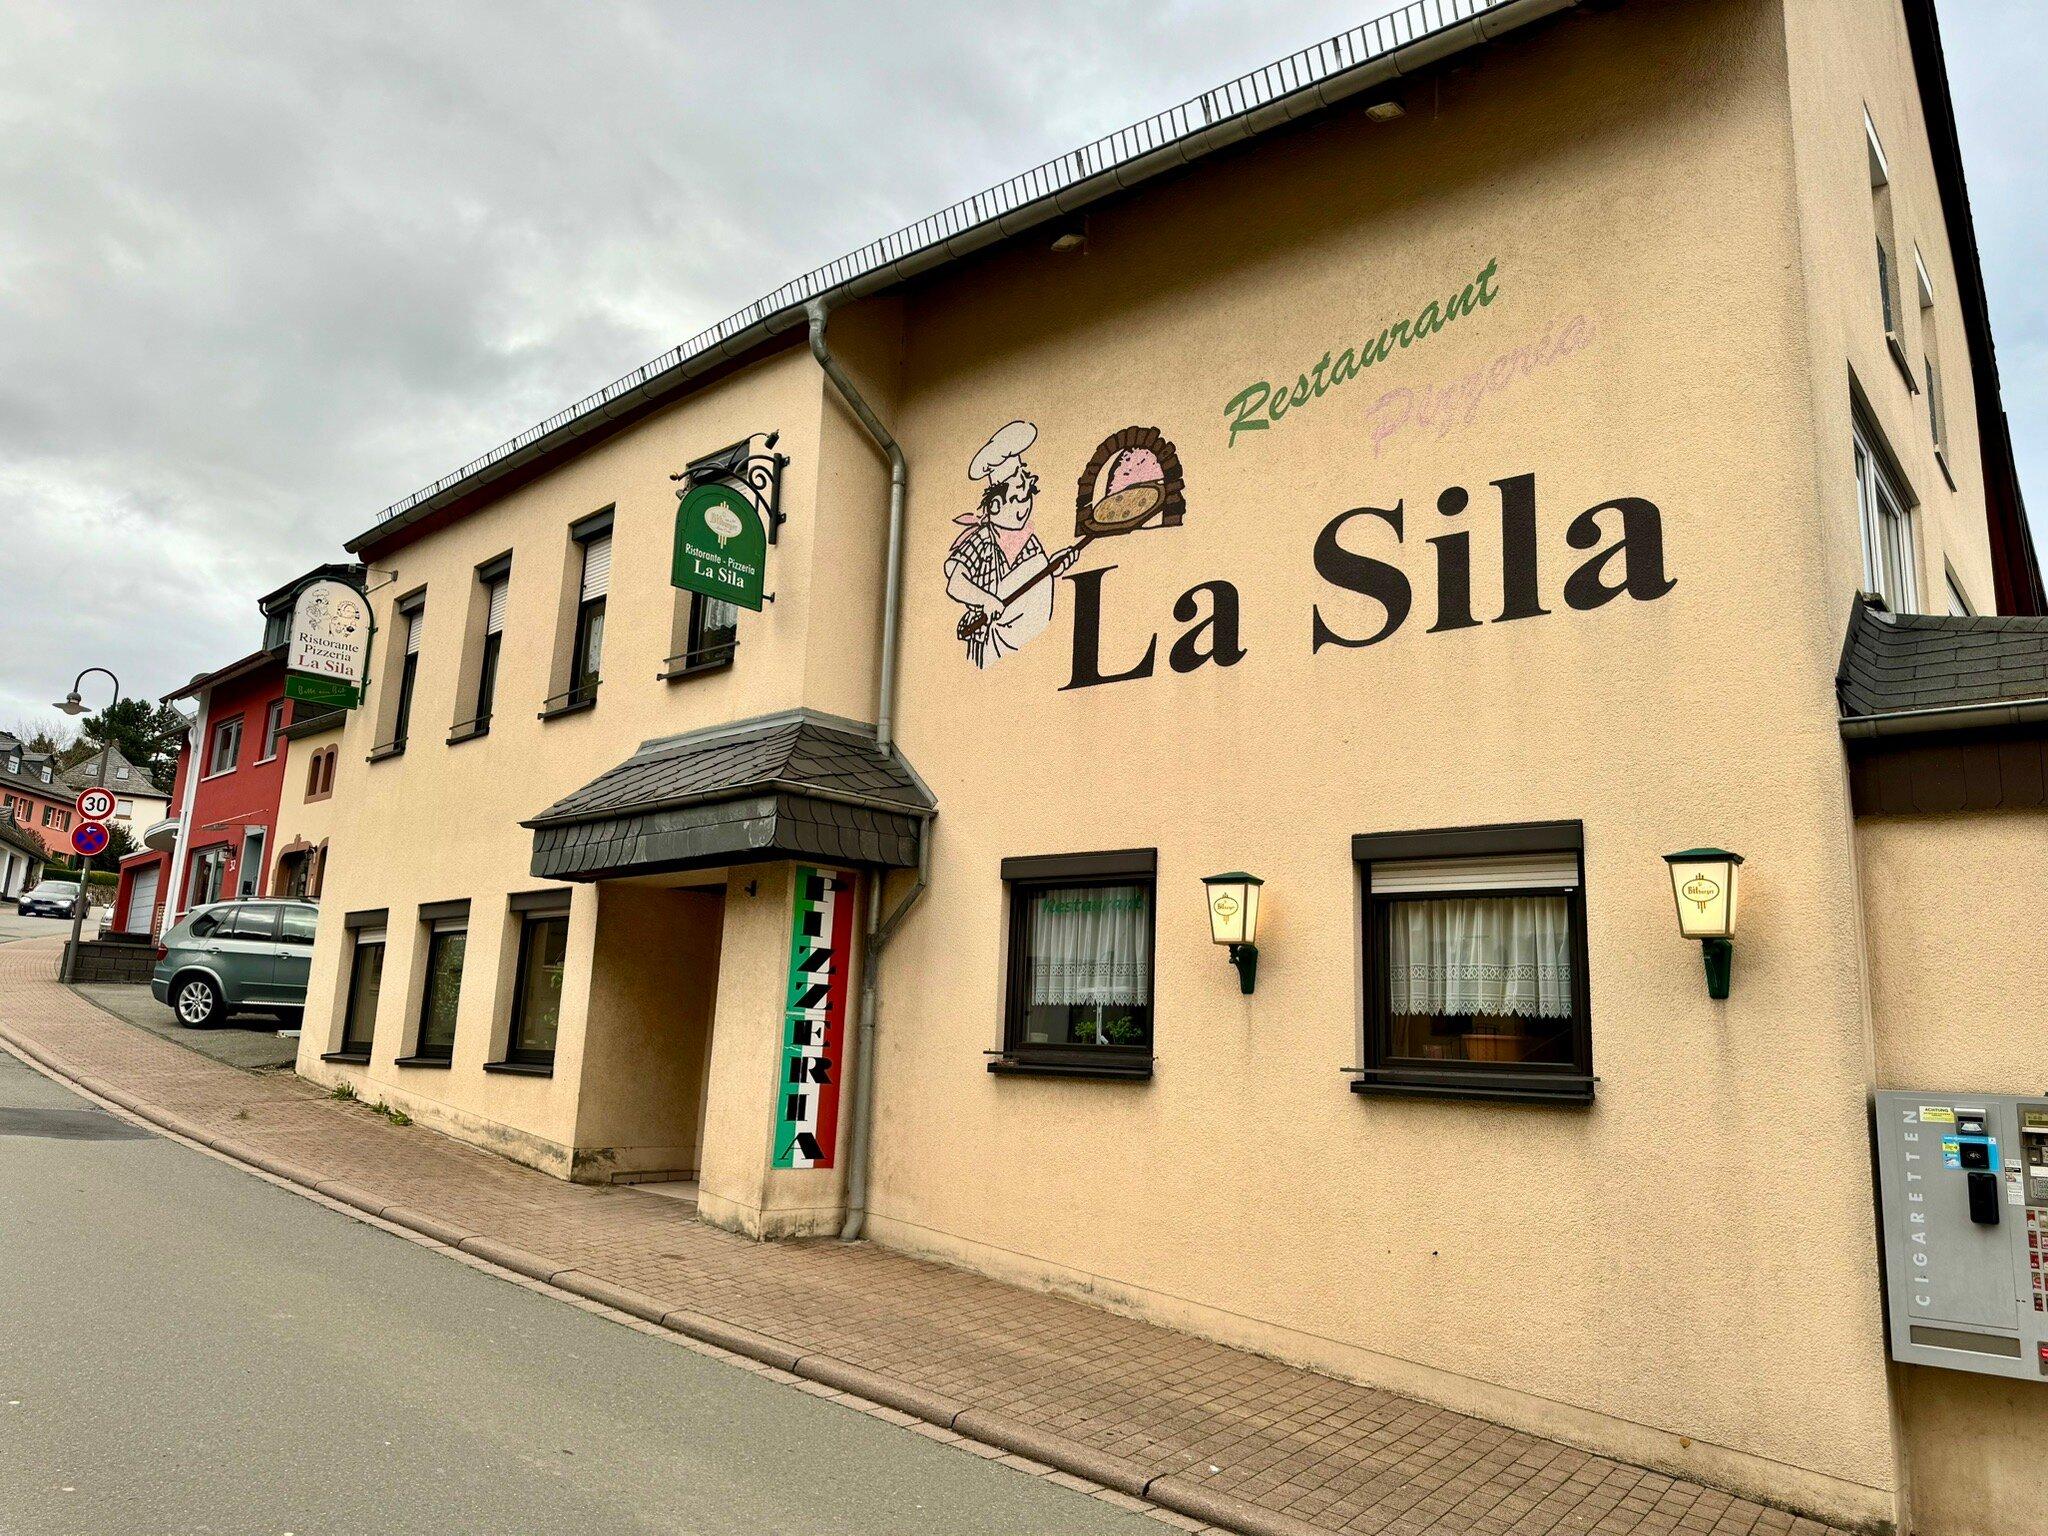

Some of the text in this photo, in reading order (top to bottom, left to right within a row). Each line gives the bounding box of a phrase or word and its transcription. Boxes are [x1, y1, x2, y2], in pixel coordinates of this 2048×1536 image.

[1223, 257, 1500, 448] Restaurant
[1364, 308, 1596, 457] Pizzeria
[686, 543, 722, 564] Ristorante
[728, 558, 755, 575] Pizzeria
[694, 560, 744, 588] La Sila
[1057, 472, 1678, 691] La Sila
[299, 633, 359, 652] Ristorante
[305, 645, 351, 661] Pizzeria
[299, 655, 354, 676] La Sila
[84, 796, 108, 812] 30
[1041, 892, 1143, 913] Restaurant
[779, 875, 848, 1160] PIZZERIA
[1902, 1110, 1932, 1307] CIGARETTEN
